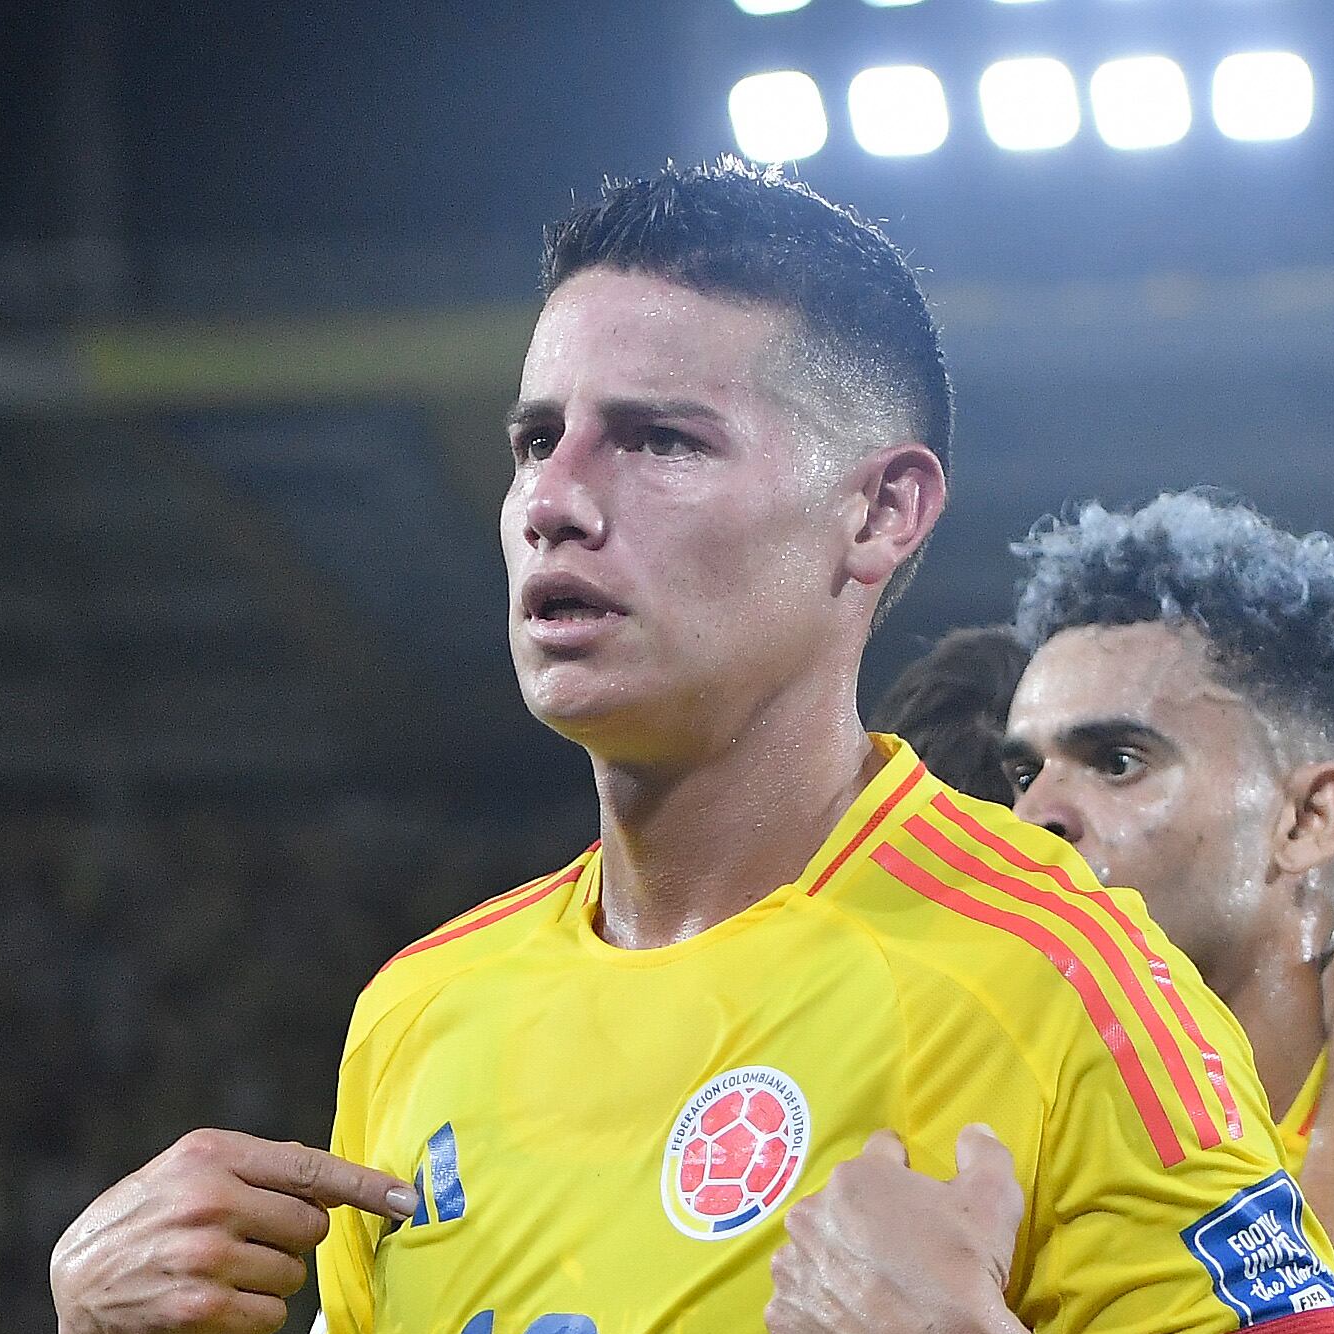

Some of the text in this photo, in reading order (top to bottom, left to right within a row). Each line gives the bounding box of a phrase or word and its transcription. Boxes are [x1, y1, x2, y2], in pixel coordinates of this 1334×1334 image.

[722, 1072, 788, 1095] COLOMBIANA
[783, 1090, 797, 1106] DE
[1250, 1278, 1285, 1301] the
[1299, 1291, 1327, 1311] FIFA
